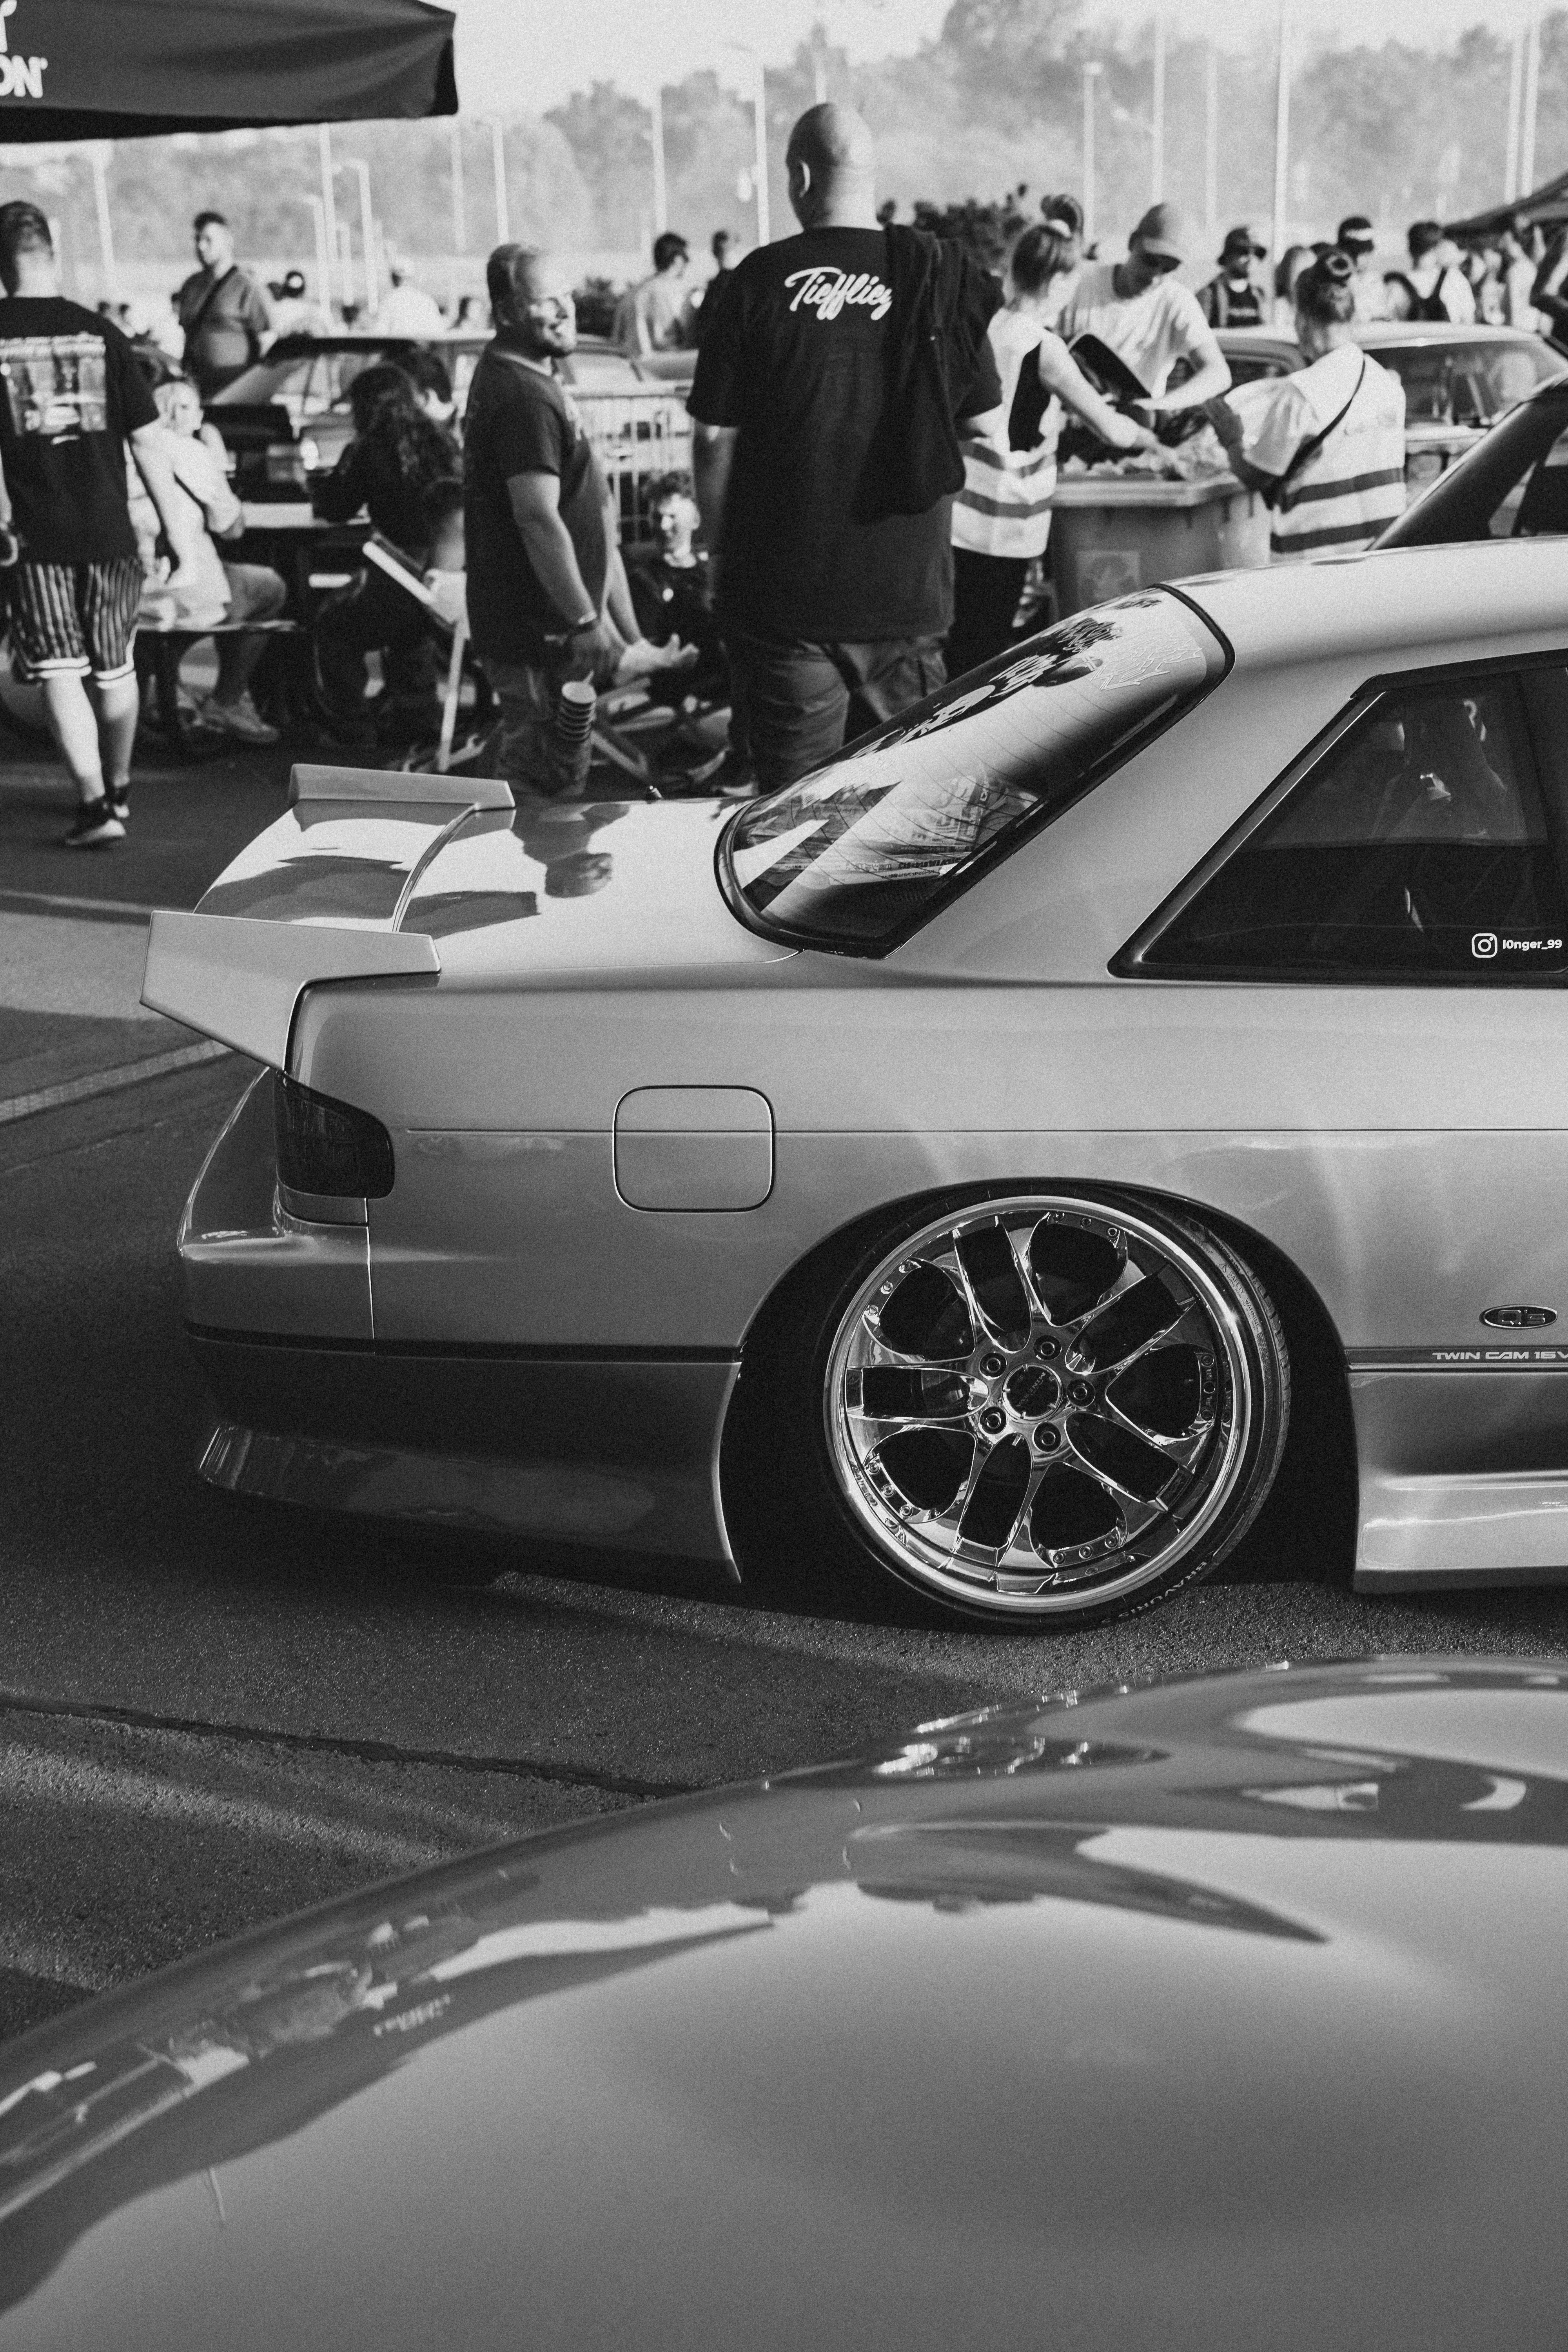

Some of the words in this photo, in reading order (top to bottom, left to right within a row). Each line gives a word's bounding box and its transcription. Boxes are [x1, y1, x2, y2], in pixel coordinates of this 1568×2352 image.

[1432, 1352, 1480, 1360] TWIN
[1485, 1351, 1529, 1359] CAM
[1118, 1561, 1207, 1617] BRAVURIS
